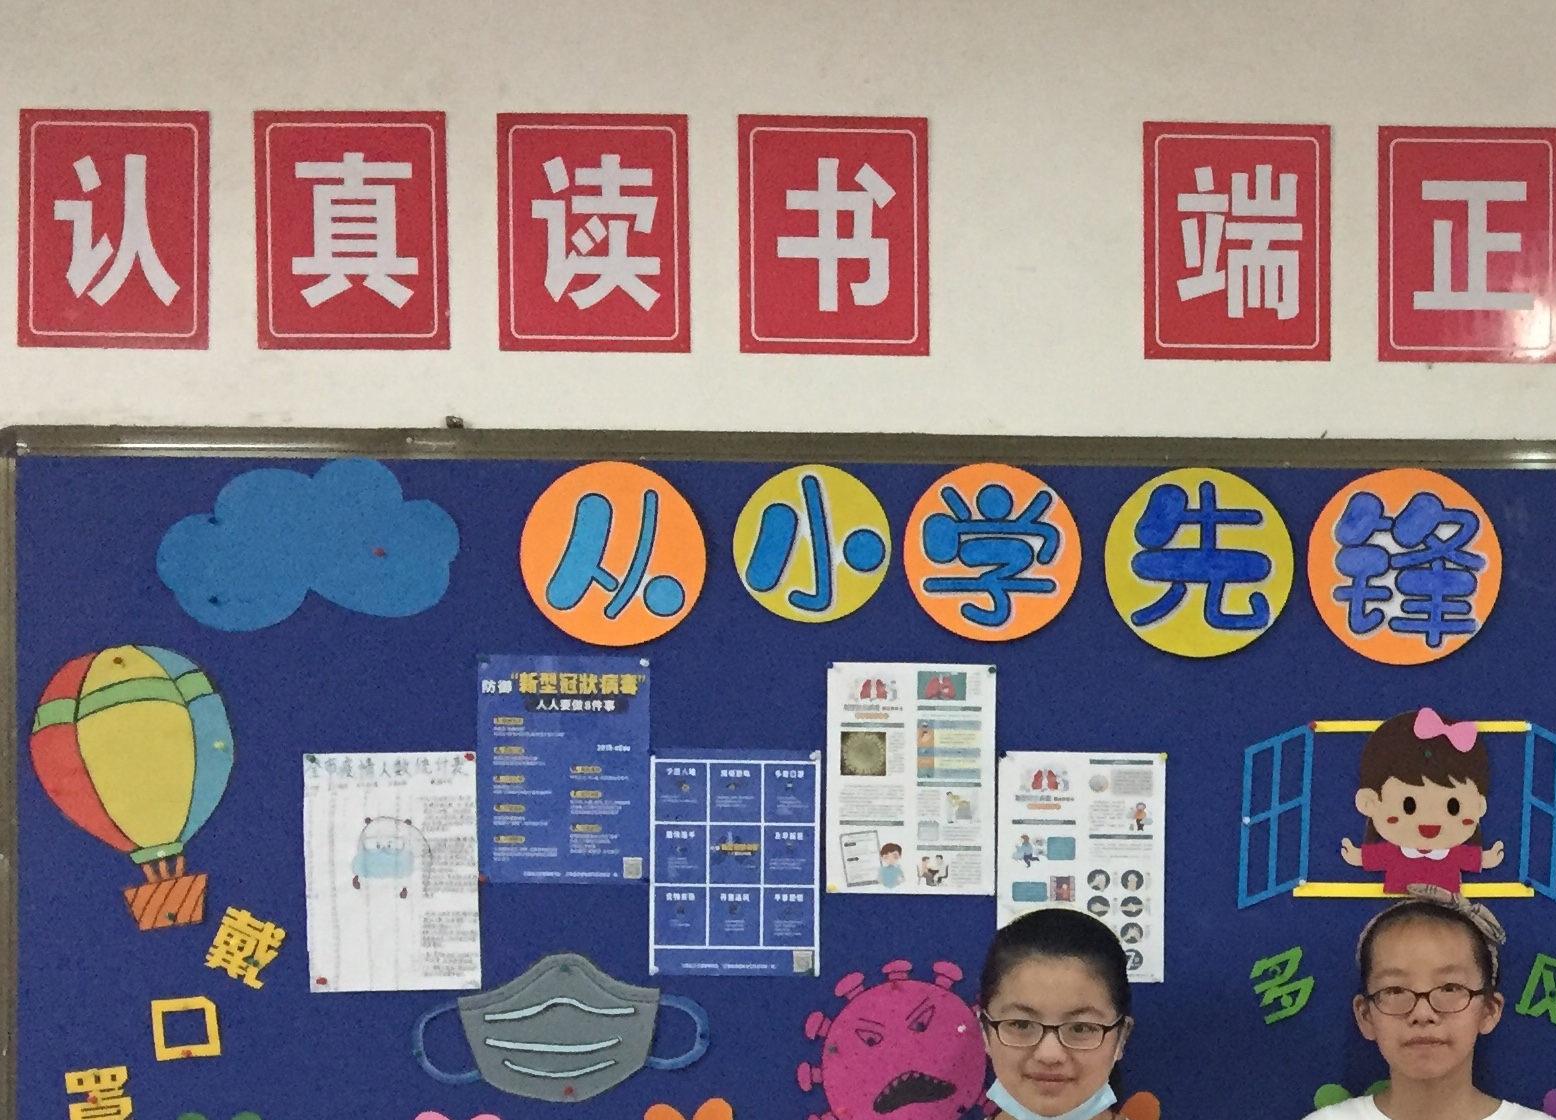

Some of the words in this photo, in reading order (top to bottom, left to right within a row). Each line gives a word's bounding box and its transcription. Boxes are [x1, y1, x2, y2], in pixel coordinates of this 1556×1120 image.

[54, 153, 896, 312] 认真读书
[545, 473, 1487, 646] 从小学先锋
